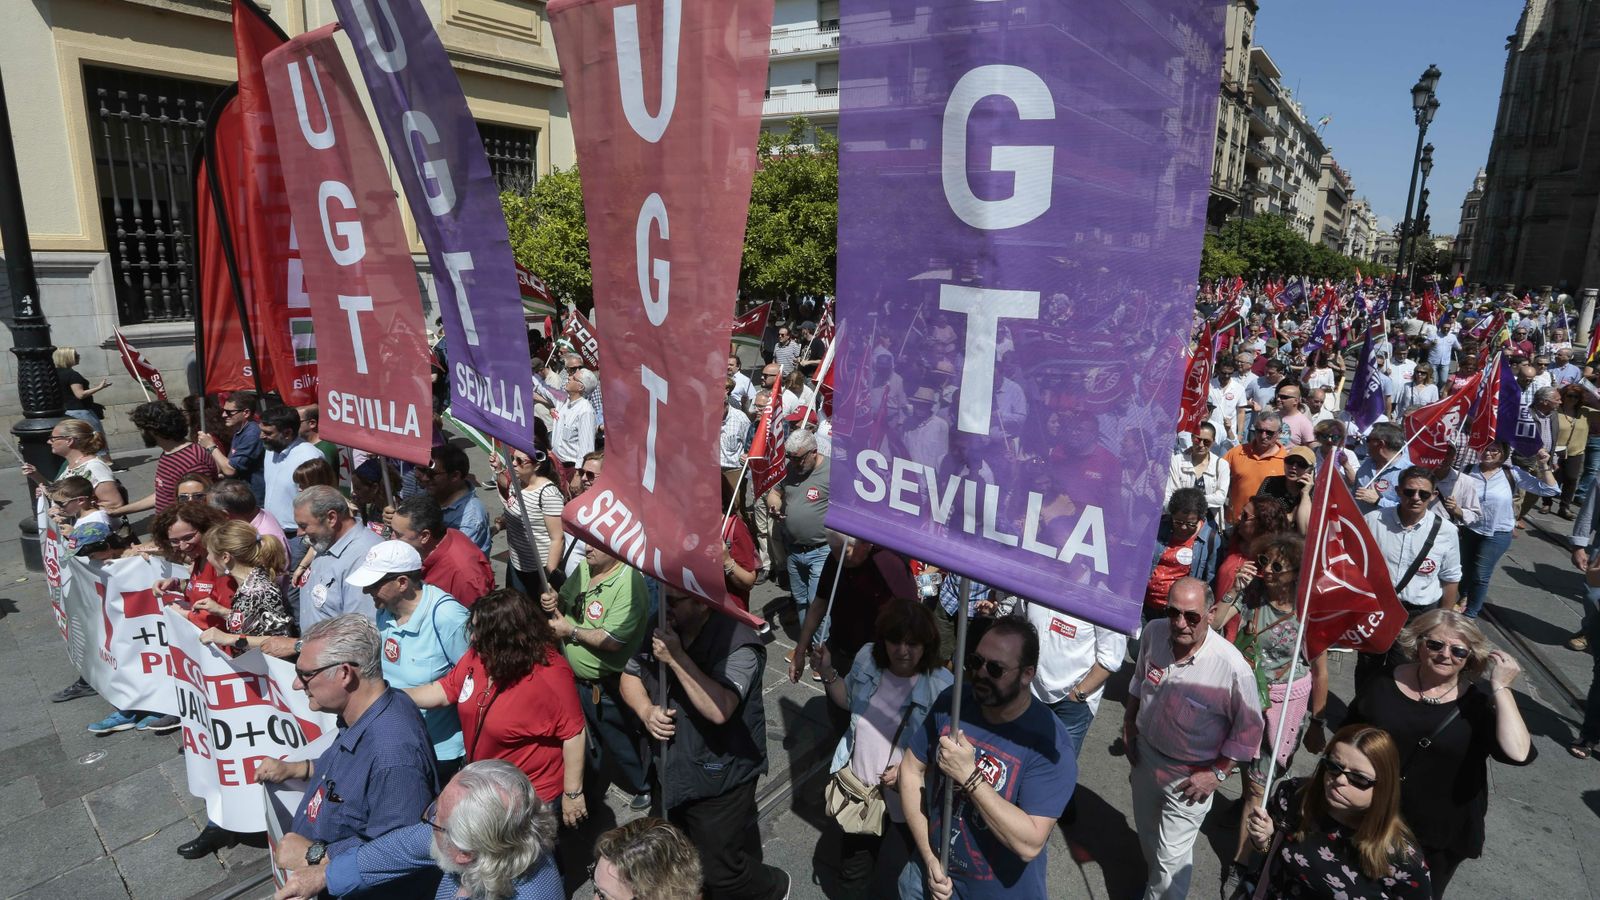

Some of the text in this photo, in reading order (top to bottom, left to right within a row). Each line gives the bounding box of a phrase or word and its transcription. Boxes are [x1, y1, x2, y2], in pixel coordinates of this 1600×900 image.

[327, 390, 421, 437] SEVILLA
[456, 361, 526, 427] SEVILLA
[853, 449, 1110, 575] SEVILLA
